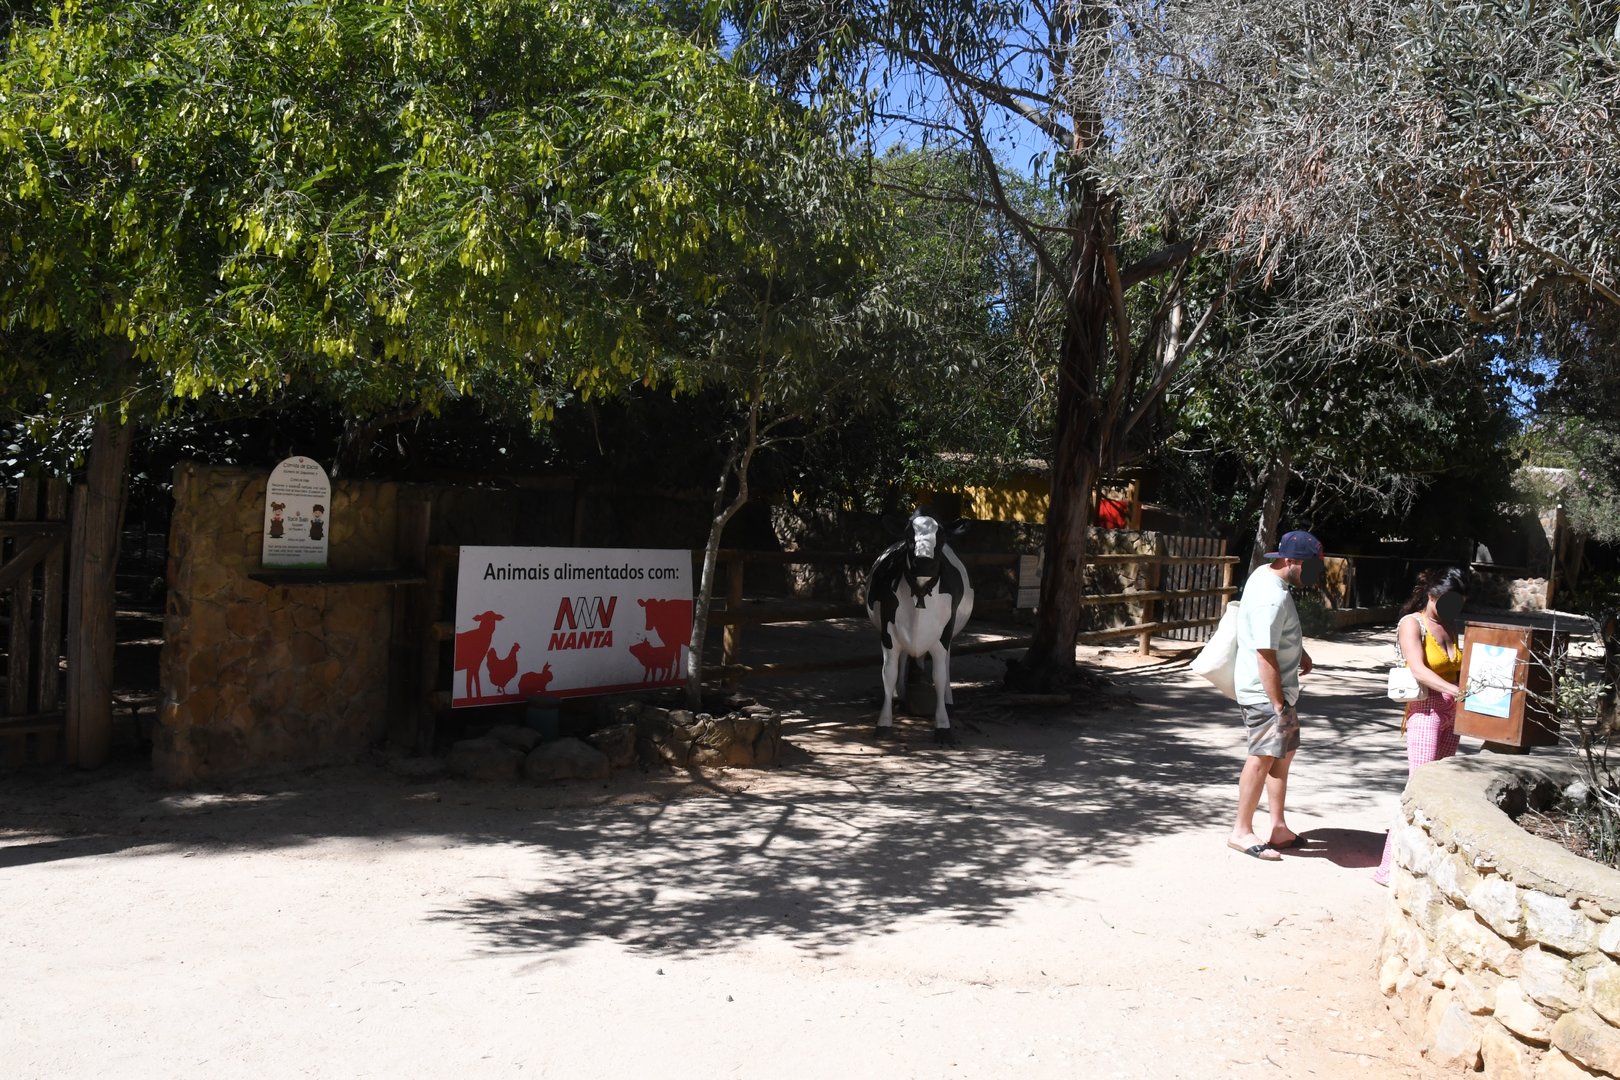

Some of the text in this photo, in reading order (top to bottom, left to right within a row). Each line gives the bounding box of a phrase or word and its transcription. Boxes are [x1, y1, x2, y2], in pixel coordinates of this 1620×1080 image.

[484, 563, 680, 580] Animais alimentados com:
[548, 630, 613, 651] NANTA
